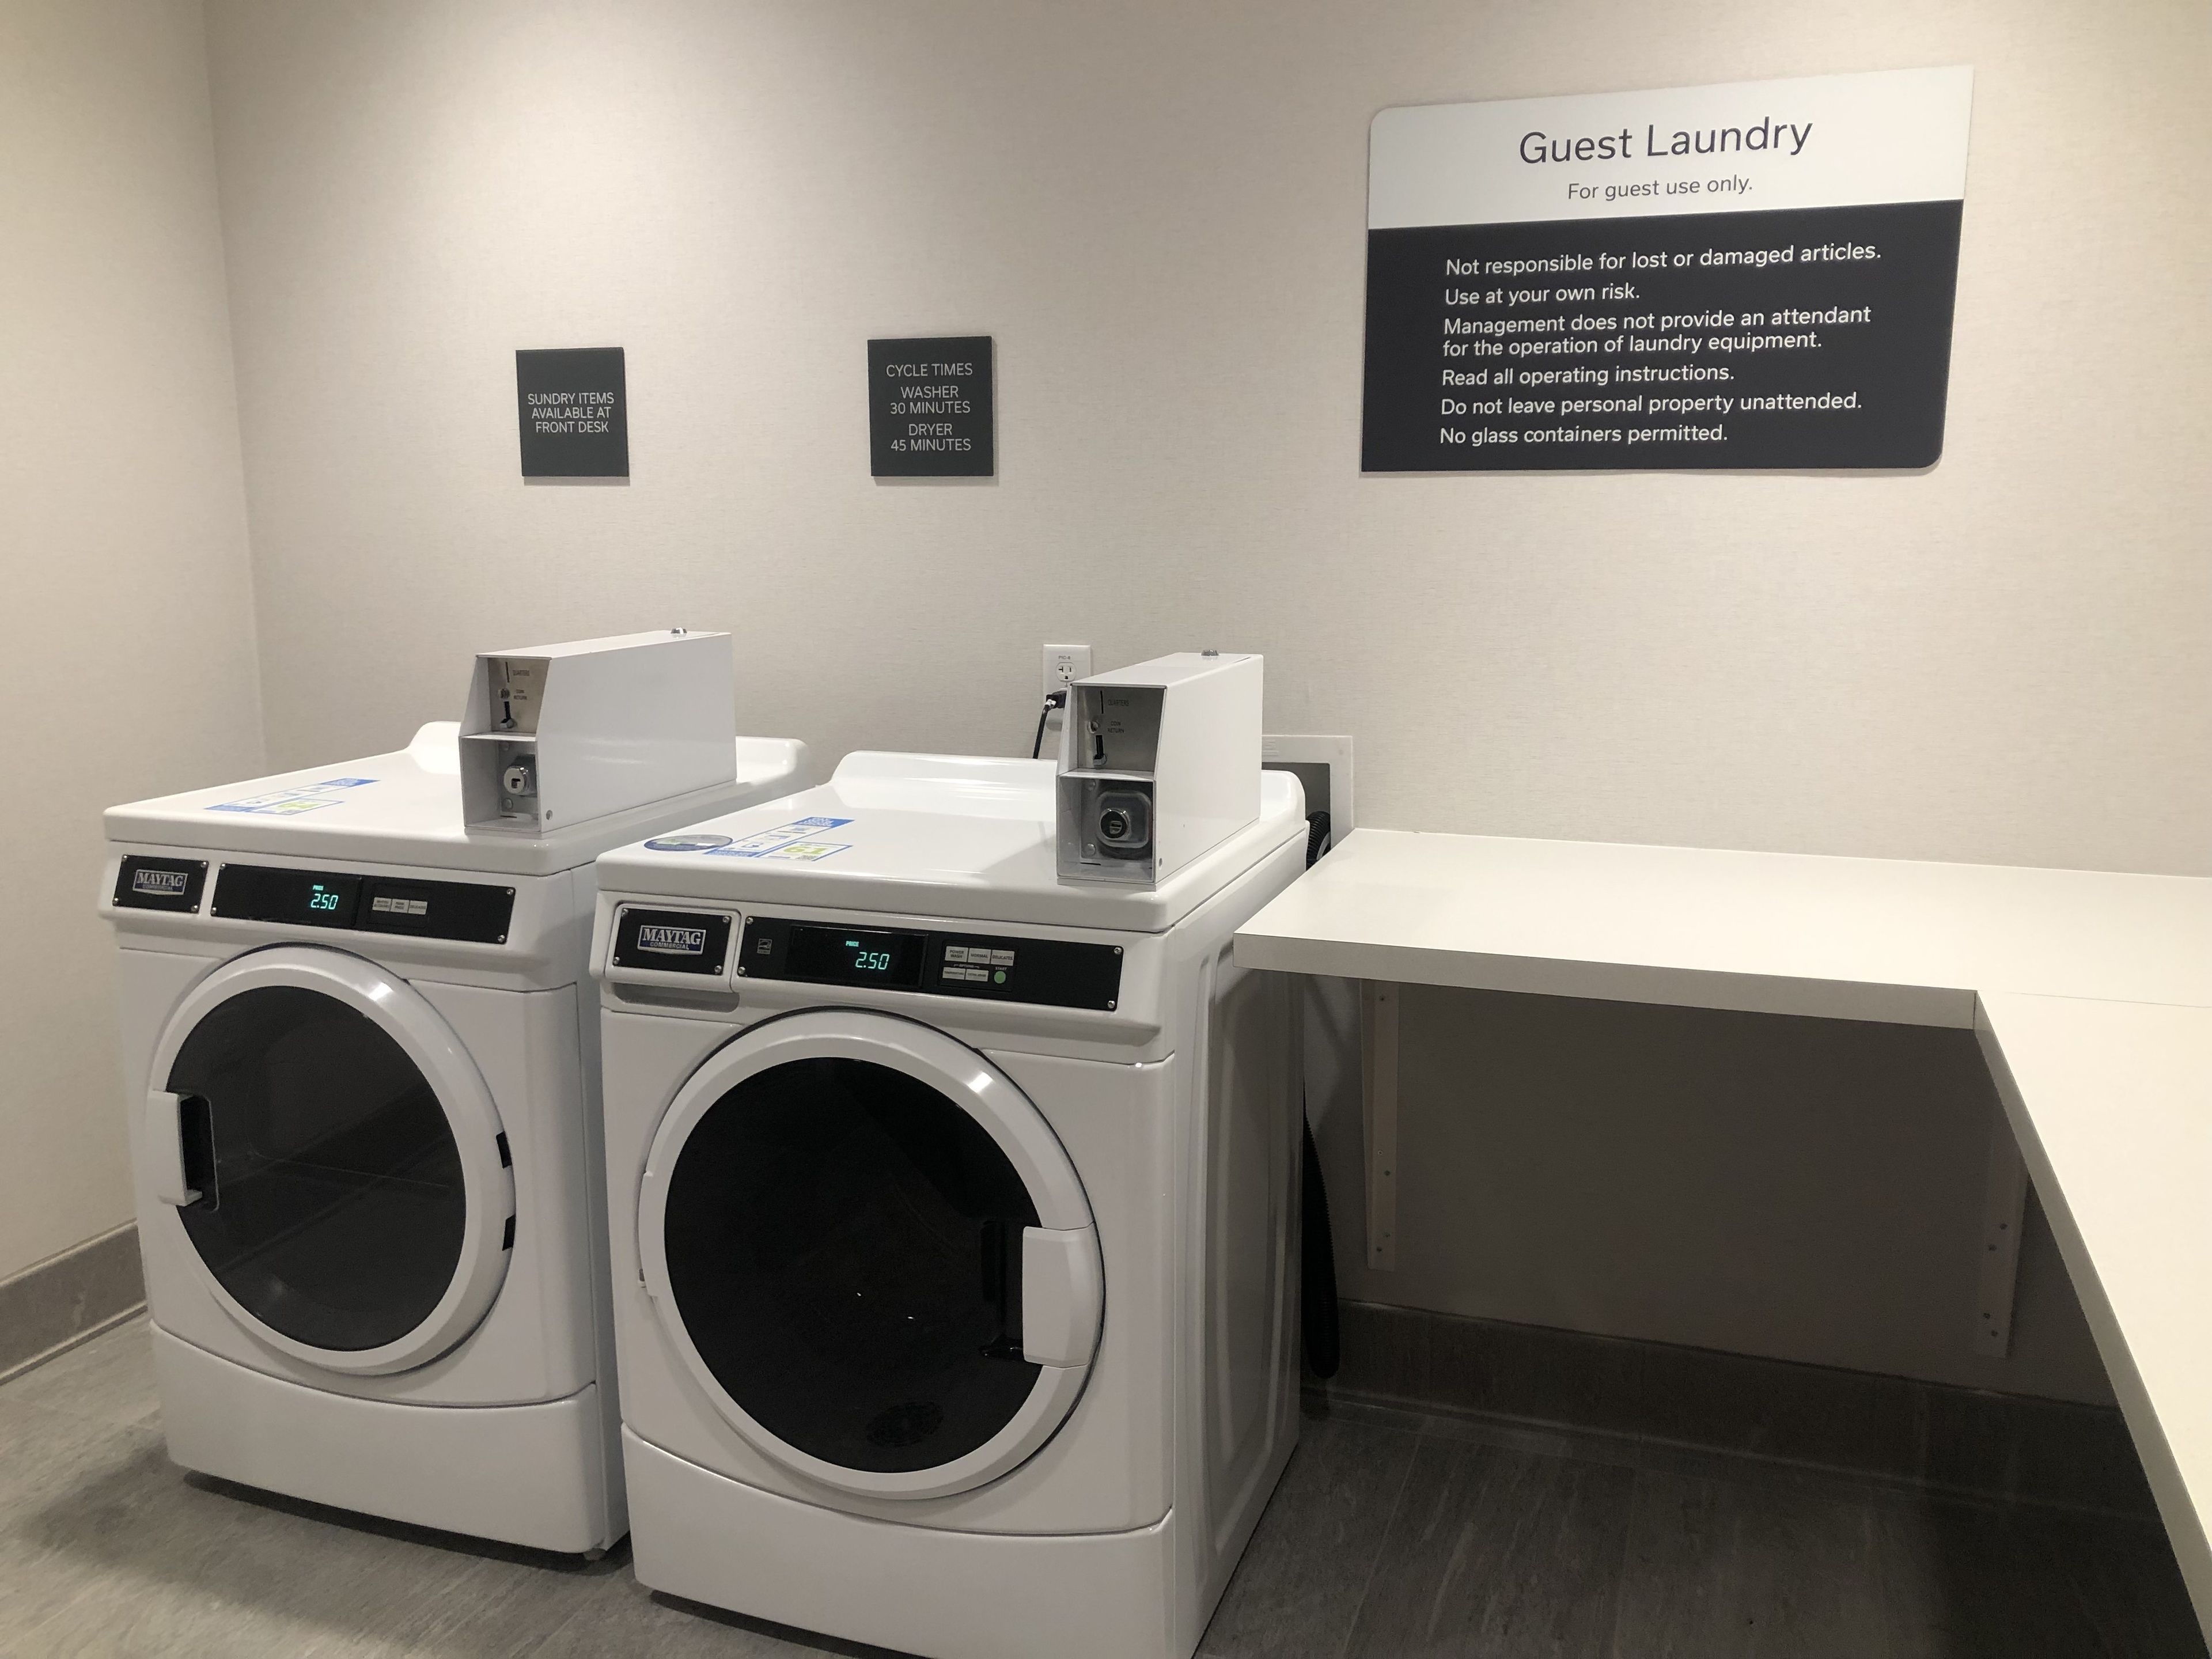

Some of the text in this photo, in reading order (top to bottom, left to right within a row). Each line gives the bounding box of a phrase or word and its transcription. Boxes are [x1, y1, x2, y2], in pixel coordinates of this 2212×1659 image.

[1520, 116, 1812, 164] Guest Laundry
[1569, 175, 1752, 202] For guest use only.
[1446, 242, 1881, 276] Not responsible for lost or damaged articles.
[1445, 282, 1640, 306] Use at your own risk.
[1444, 306, 1872, 336] Management does not provide an attendant
[1443, 331, 1821, 358] for the operation of laundry equipment.
[886, 363, 973, 377] CYCLE TIMES
[1442, 363, 1734, 387] Read all operating instructions.
[528, 392, 615, 405] SUNDRY ITEMS
[900, 385, 959, 399] WASHER
[890, 400, 971, 414] 30 MINUTES
[1441, 391, 1862, 416] Do not leave personal property unattended.
[531, 406, 612, 419] AVAILABLE AT
[535, 421, 609, 433] FRONT DESK
[908, 423, 952, 436] DRYER
[1440, 423, 1728, 447] No glass containers permitted.
[891, 438, 971, 451] 45 MINUTES
[137, 872, 184, 887] MAYTAG
[310, 893, 339, 910] 2.50
[642, 928, 700, 944] MAYTAG
[855, 951, 890, 970] 2.50
